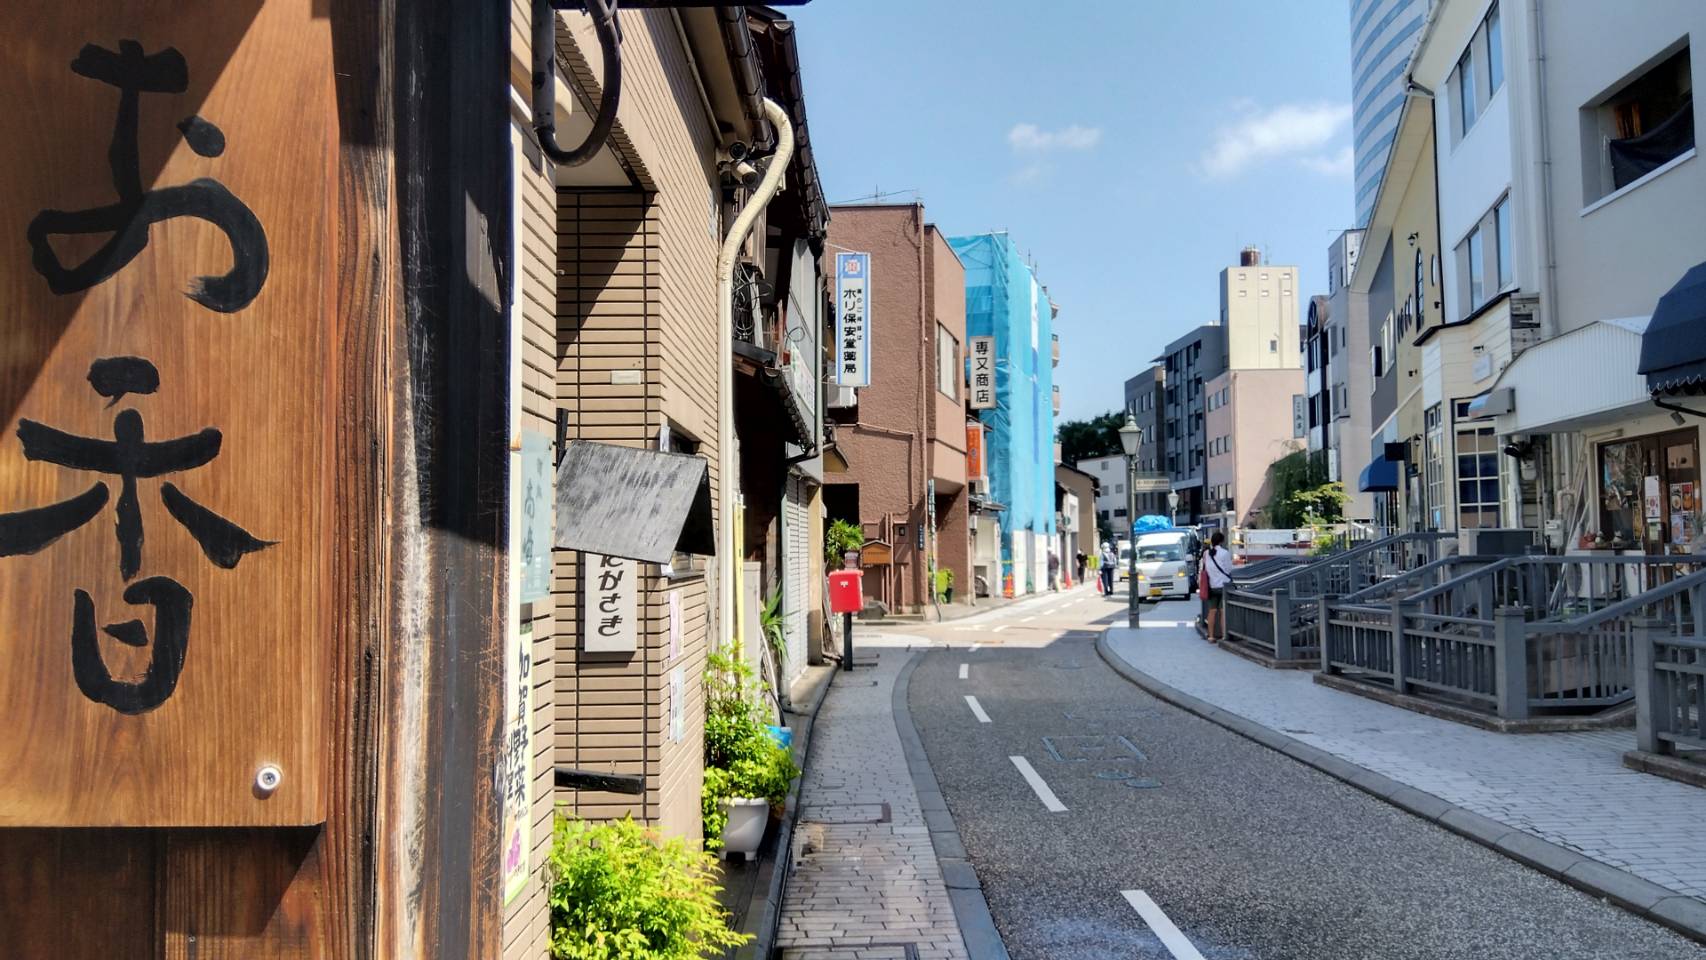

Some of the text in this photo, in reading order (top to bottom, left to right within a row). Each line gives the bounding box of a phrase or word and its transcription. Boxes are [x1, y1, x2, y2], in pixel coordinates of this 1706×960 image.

[0, 39, 281, 716] お香
[843, 288, 857, 374] ホリ保安堂薬局
[975, 341, 989, 403] 専又商店
[513, 641, 531, 807] 加賀野菜
